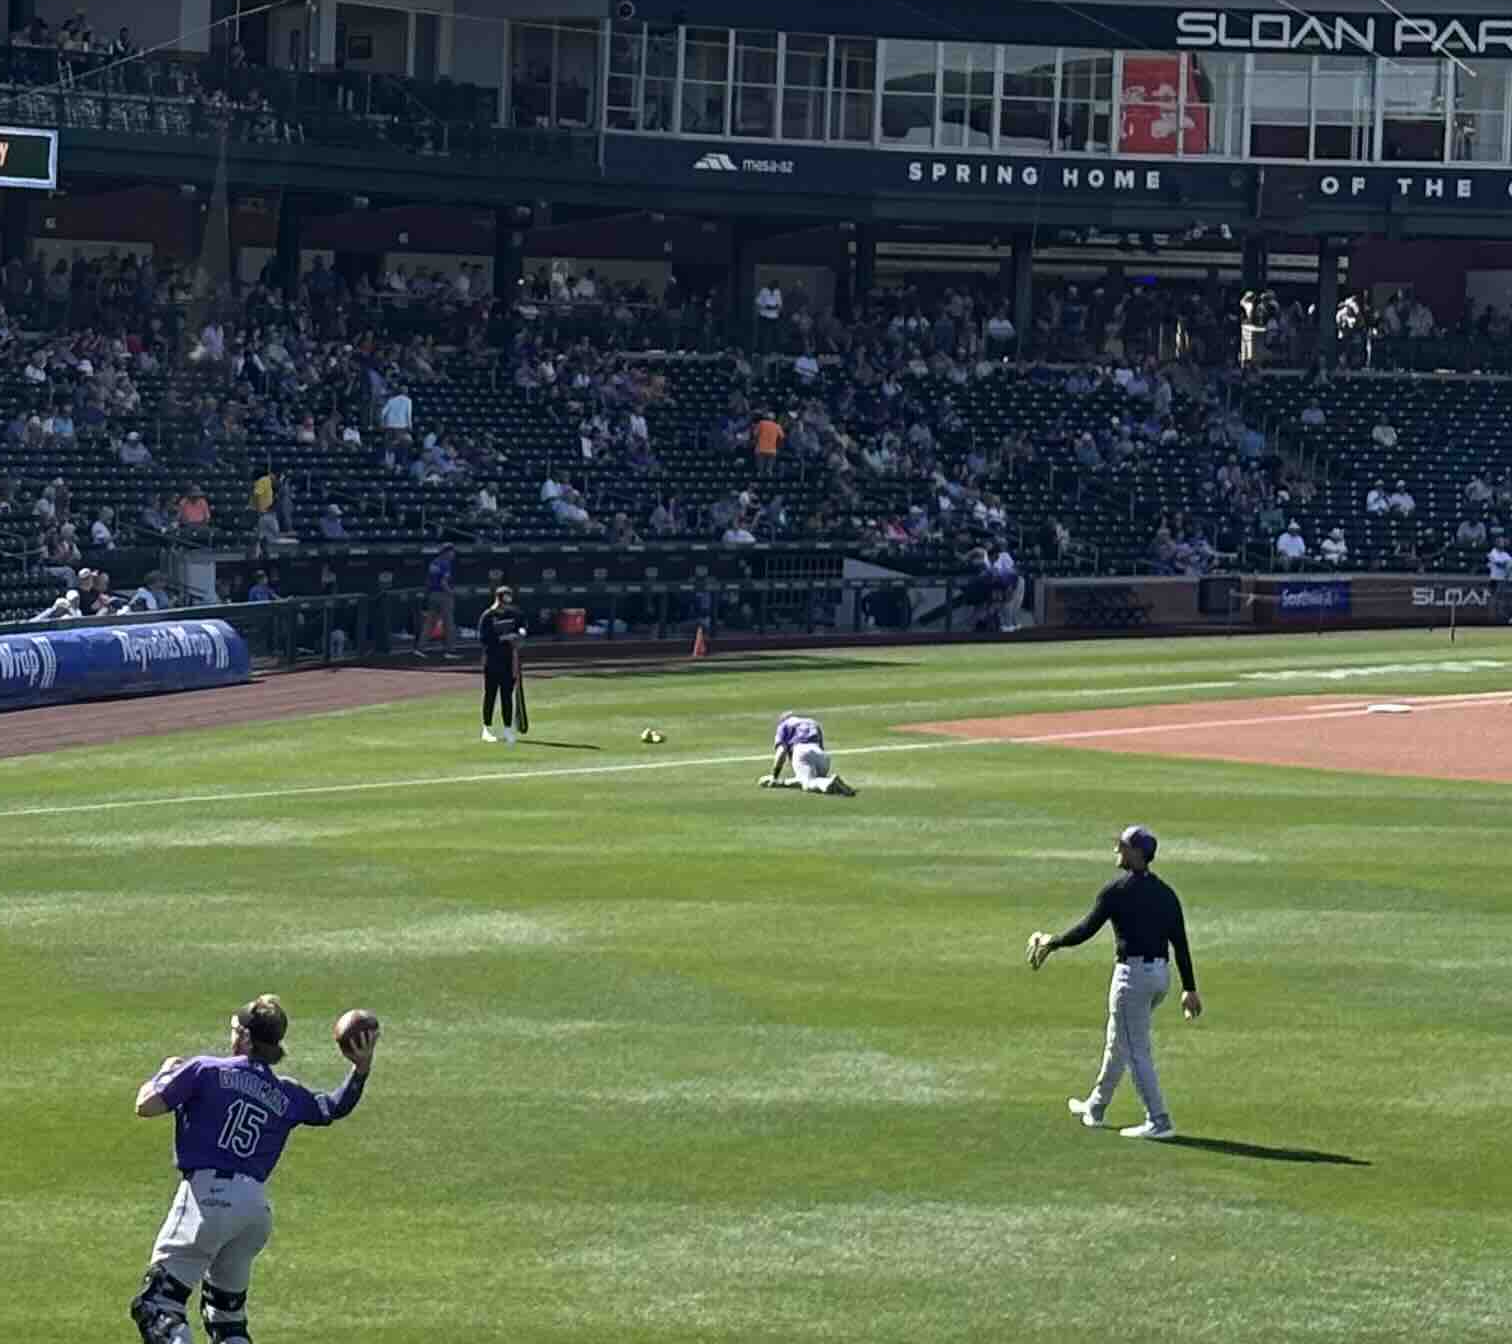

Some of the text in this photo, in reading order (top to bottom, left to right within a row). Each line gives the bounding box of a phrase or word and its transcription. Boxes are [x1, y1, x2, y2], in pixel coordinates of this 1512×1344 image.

[1176, 11, 1512, 53] SLOAN PAR
[908, 162, 1473, 197] SPRING HOME OF THE
[217, 1099, 268, 1157] 15
